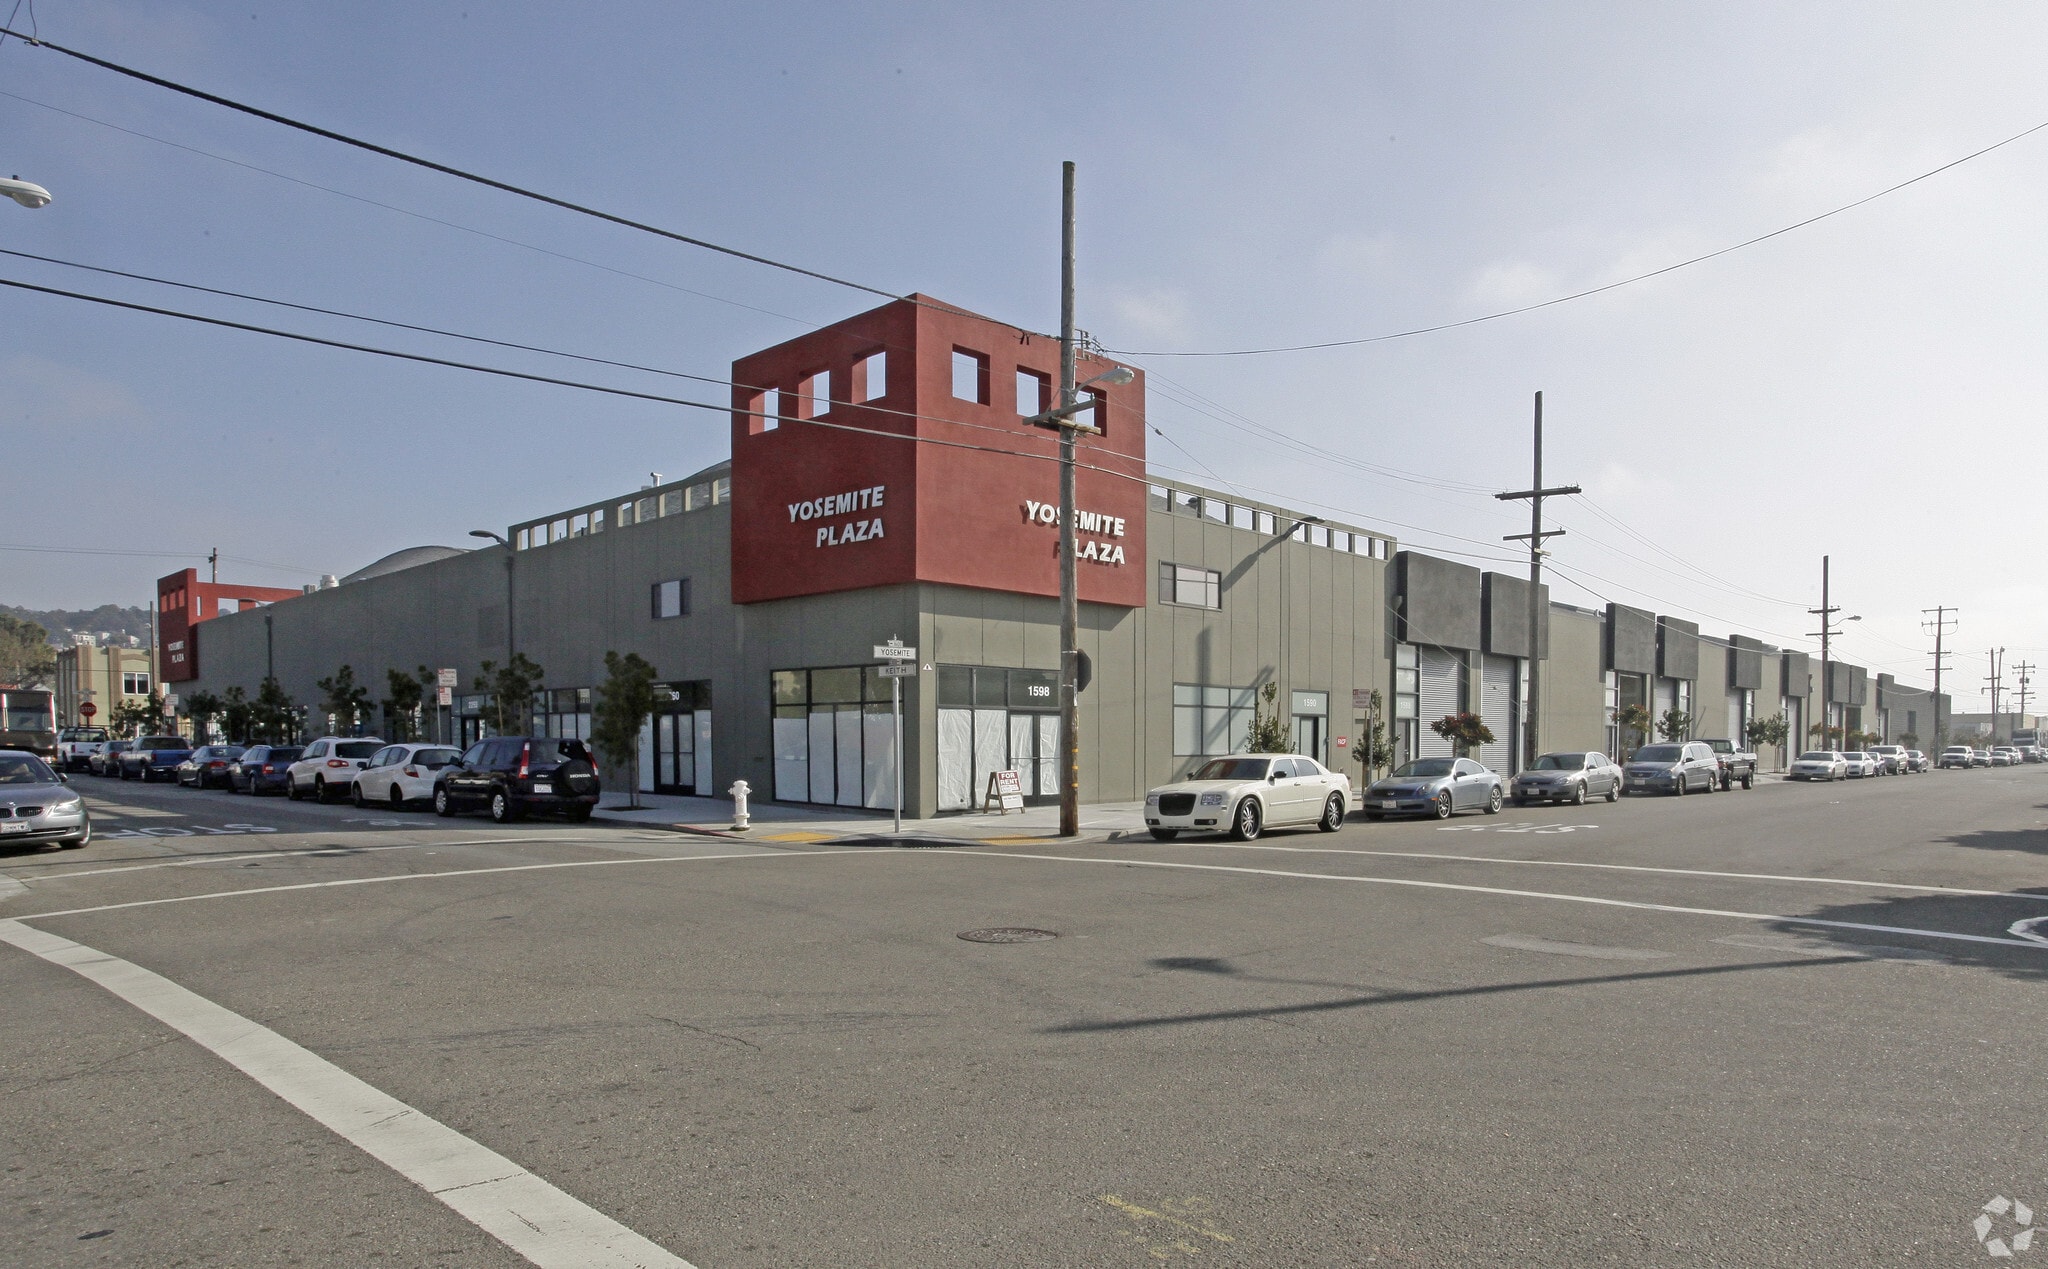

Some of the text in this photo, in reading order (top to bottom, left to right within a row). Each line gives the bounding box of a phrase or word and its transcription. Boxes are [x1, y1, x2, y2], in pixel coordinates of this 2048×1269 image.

[788, 485, 885, 523] YOSEMITE
[816, 517, 884, 548] PLAZA
[1074, 538, 1125, 565] LAZA
[880, 648, 911, 657] YOSEMITE
[885, 666, 907, 675] KEITH
[1027, 685, 1050, 697] 1598
[1303, 698, 1317, 707] 1590
